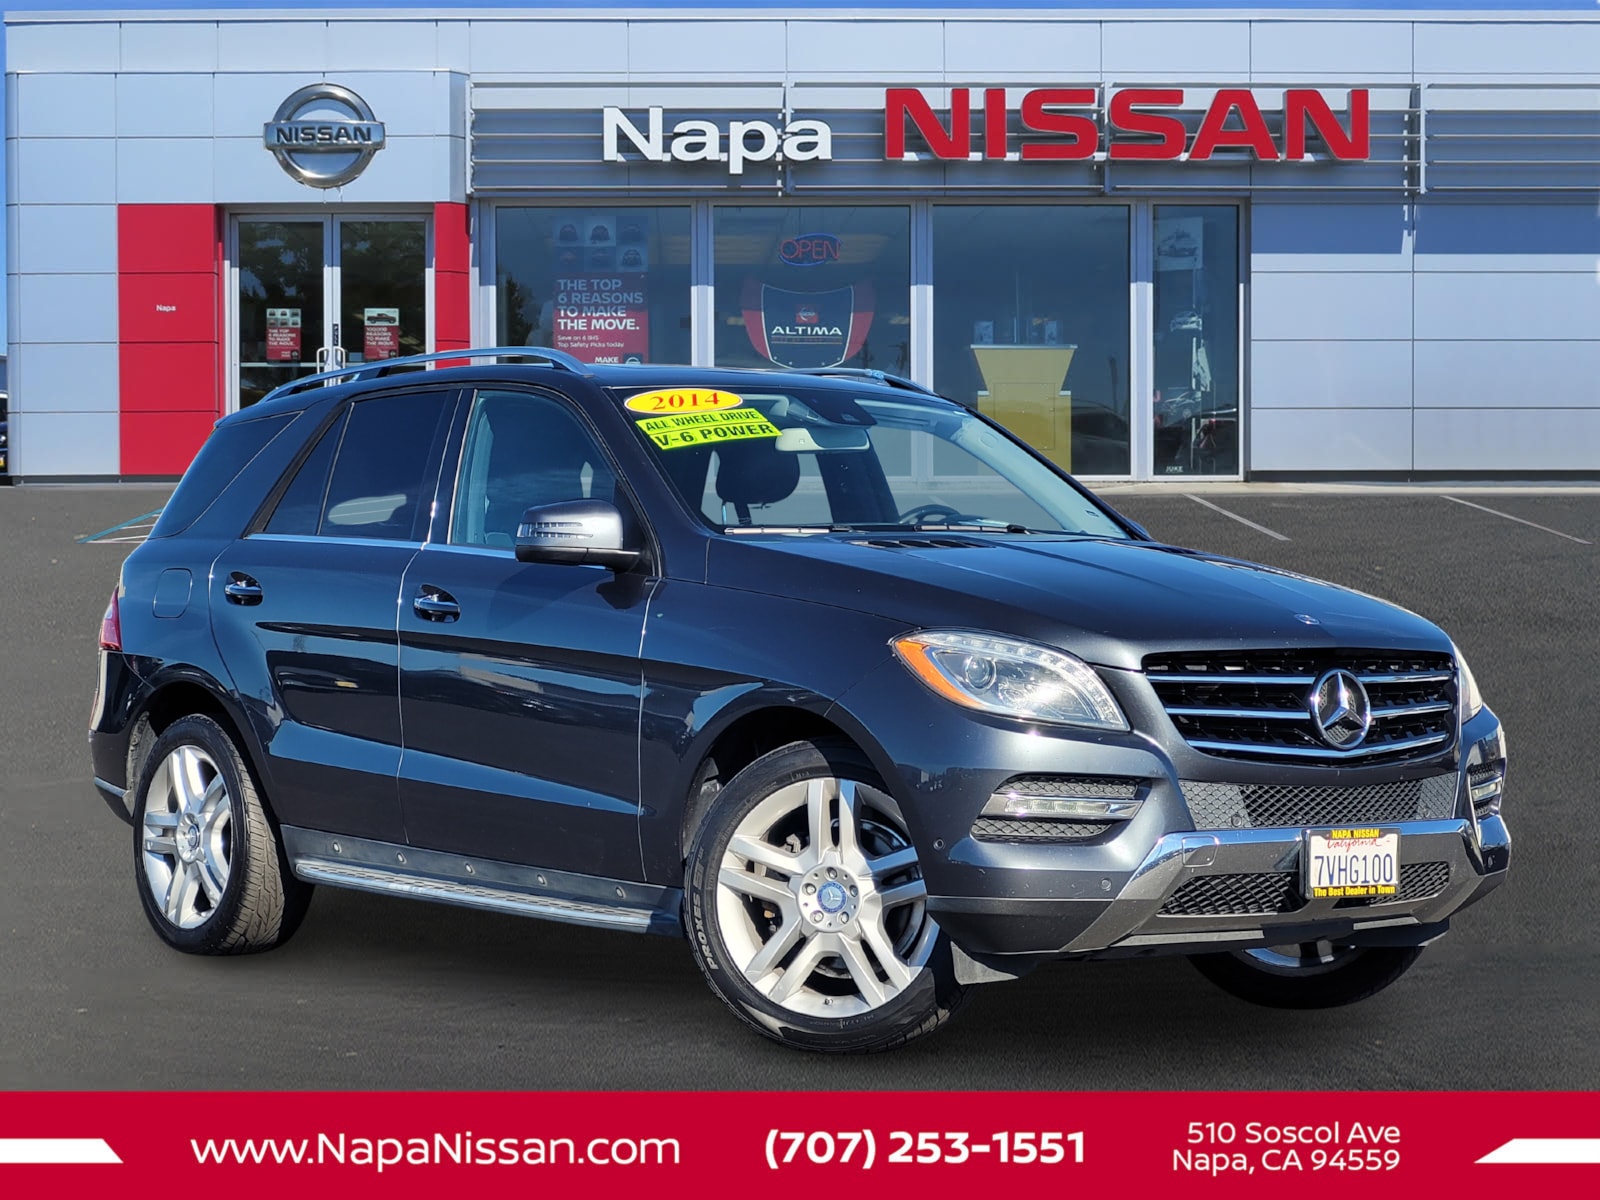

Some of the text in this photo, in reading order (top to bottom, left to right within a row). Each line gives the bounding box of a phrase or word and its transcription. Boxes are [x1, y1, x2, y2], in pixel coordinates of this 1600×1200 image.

[276, 126, 372, 143] NISSAN
[603, 87, 1370, 175] Napa NISSAN
[780, 239, 842, 260] OPEN
[557, 279, 622, 290] THE TOP
[557, 292, 643, 304] 6 REASONS
[156, 304, 177, 312] Napa
[557, 305, 626, 317] TO MAKE
[557, 319, 640, 330] THE MOVE.
[771, 326, 843, 335] ALTIMA
[650, 392, 720, 411] 2014
[645, 410, 759, 432] ALL WHEEL DRIVE
[655, 423, 773, 447] V-6 POWER
[1331, 828, 1380, 839] NAPA NISSAN
[1327, 838, 1383, 853] California
[1314, 853, 1393, 886] 7VHG100
[1313, 884, 1396, 897] The Best Dealer in Town
[693, 892, 719, 970] PROXES
